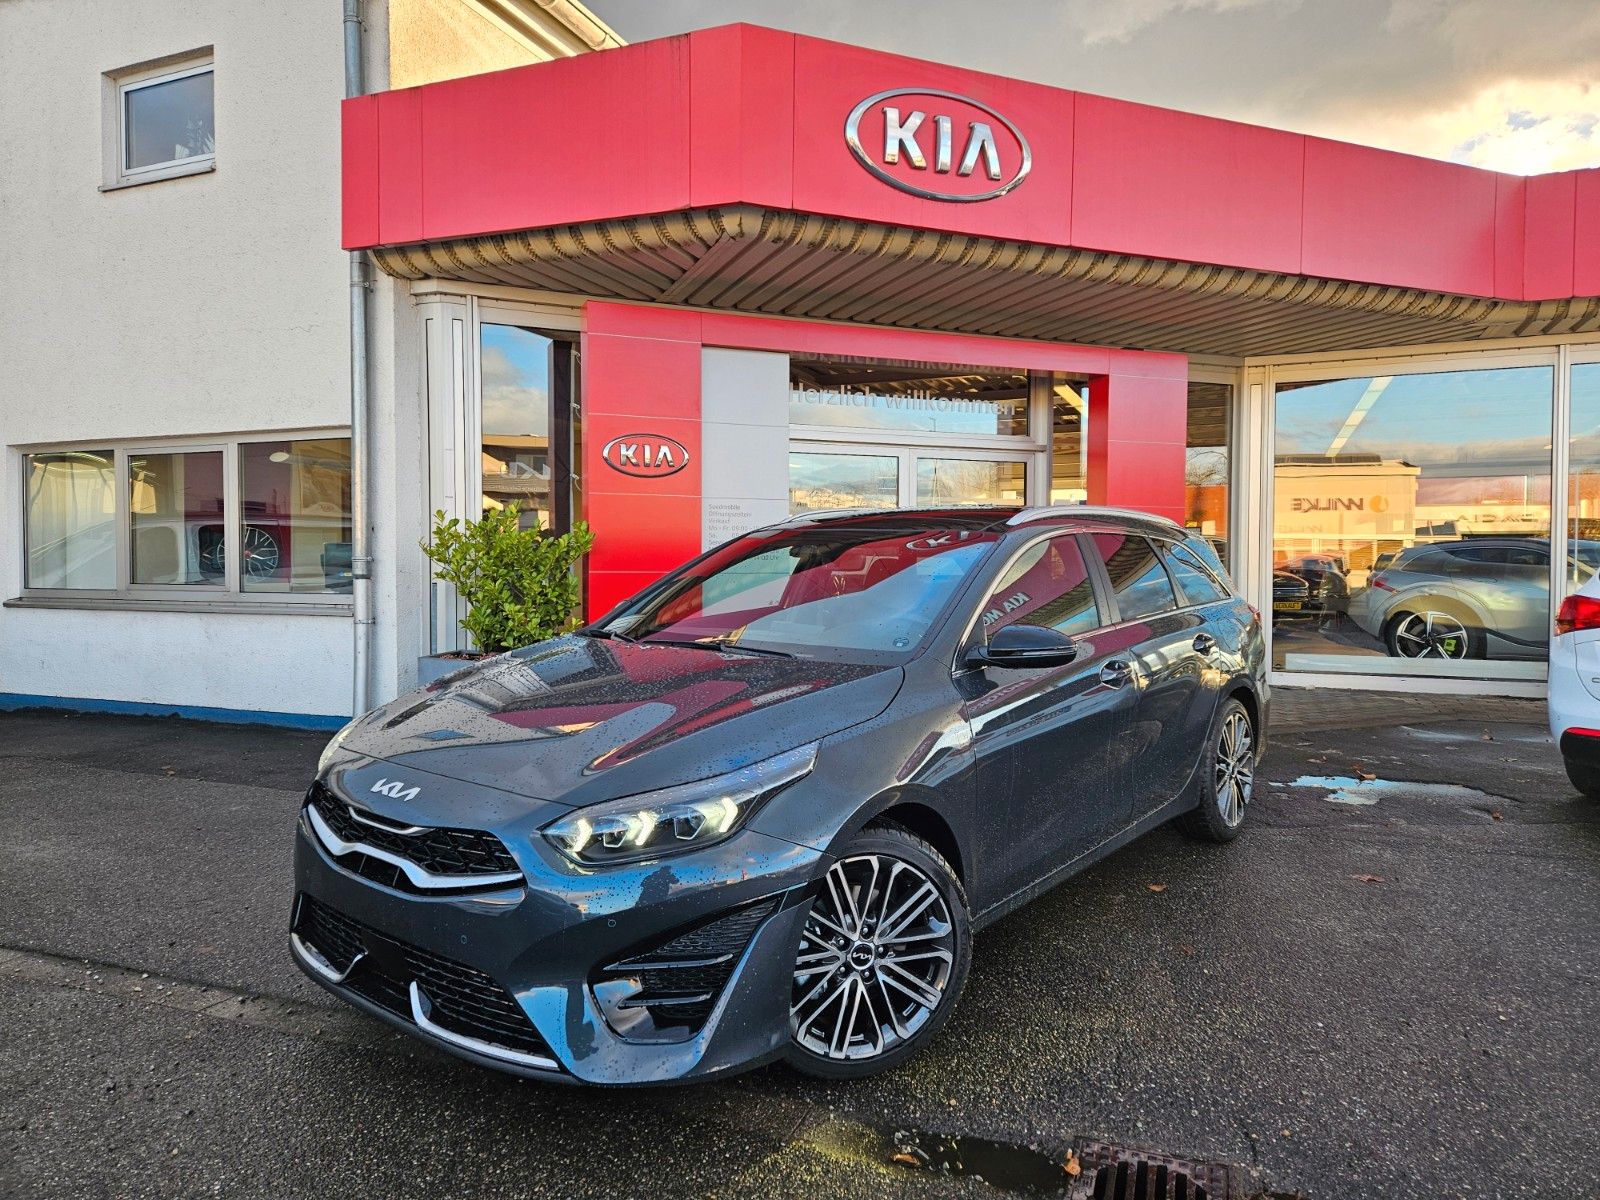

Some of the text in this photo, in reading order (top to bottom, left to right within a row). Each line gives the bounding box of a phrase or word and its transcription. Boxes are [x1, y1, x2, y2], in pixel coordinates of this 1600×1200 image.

[882, 107, 1001, 180] KIA
[790, 382, 1016, 415] Herzlich willkommen
[619, 443, 675, 467] KIA
